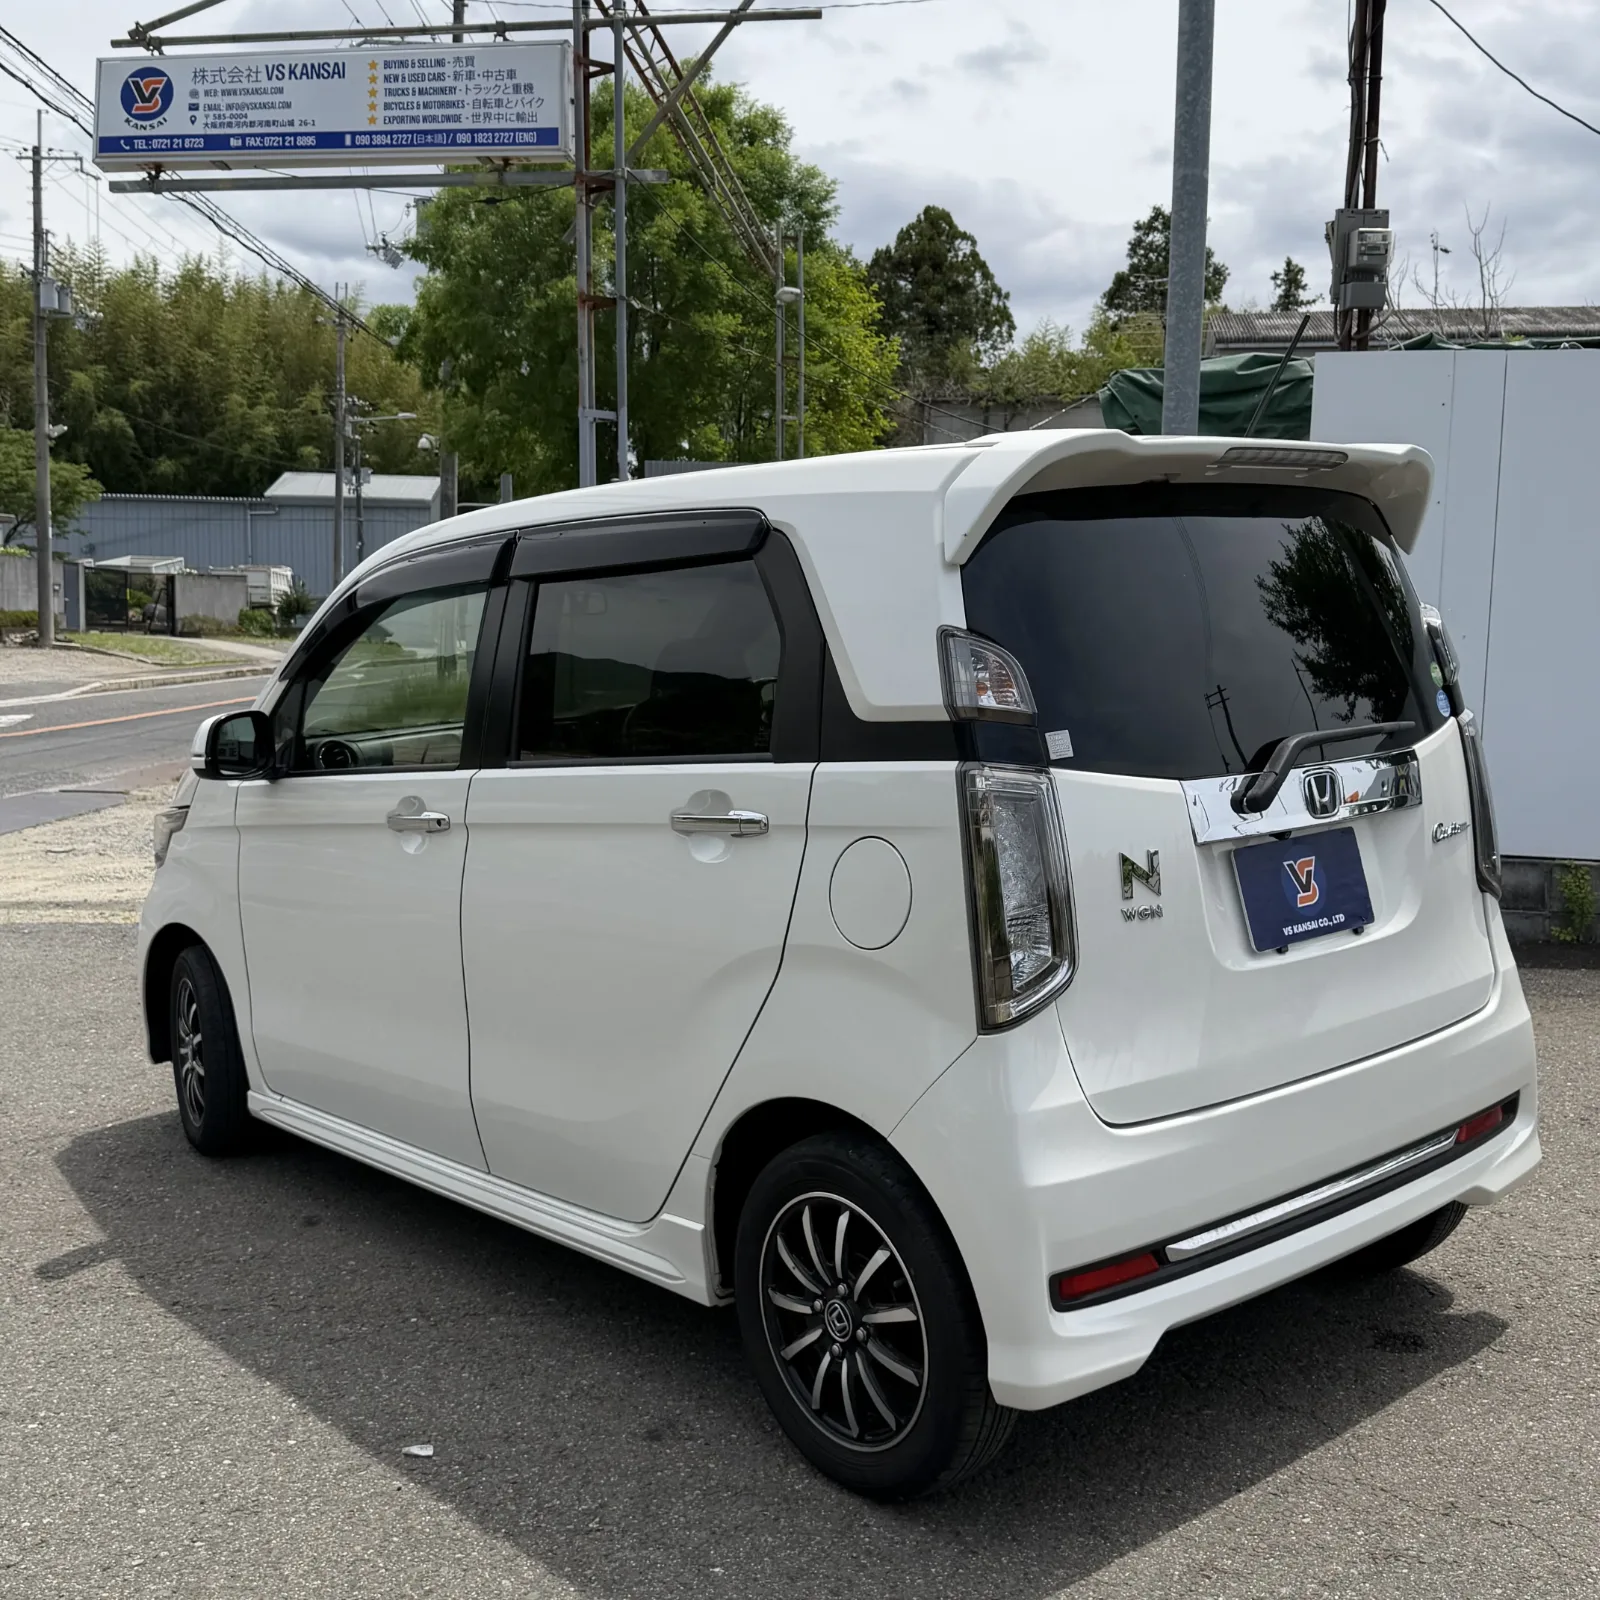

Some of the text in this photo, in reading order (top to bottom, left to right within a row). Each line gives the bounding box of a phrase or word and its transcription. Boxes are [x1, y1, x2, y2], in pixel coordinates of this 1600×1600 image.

[383, 59, 410, 70] BUYING
[410, 59, 416, 69] &
[417, 58, 446, 69] SELLING
[452, 55, 476, 69] 売買
[192, 61, 346, 85] 株式会社 VS KANSAI
[383, 73, 400, 84] NEW
[401, 73, 407, 83] &
[407, 72, 426, 83] USED
[427, 71, 446, 82] CARS
[203, 86, 284, 98] WEB: WWW.VSKANSAI.COM
[384, 87, 410, 97] TRUCKS
[411, 87, 417, 97] &
[417, 86, 458, 96] MACHINERY
[464, 82, 535, 96] トラックと重機
[383, 101, 415, 111] BICYCLES
[416, 101, 421, 110] &
[422, 100, 466, 110] MOTORBIKES
[472, 97, 545, 110] 自転車とバイク
[124, 116, 168, 131] KANSAI
[212, 113, 249, 121] 585-0004
[298, 119, 316, 127] 26-1
[383, 115, 421, 125] EXPORTING
[421, 114, 463, 124] WORLDWIDE
[471, 111, 538, 124] 世界中に輸出
[172, 139, 182, 149] 21
[184, 138, 204, 148] 8723
[284, 136, 295, 146] 21
[296, 135, 317, 146] 8895
[355, 134, 370, 145] 090
[371, 134, 391, 145] 3894
[392, 133, 412, 144] 2727
[456, 132, 471, 143] 090
[473, 132, 493, 143] 1823
[494, 132, 514, 143] 2727
[1119, 848, 1162, 901] N
[1121, 903, 1164, 922] WGN
[1283, 926, 1293, 936] VS
[1293, 920, 1319, 934] KANSAI
[1332, 913, 1346, 925] LTD
